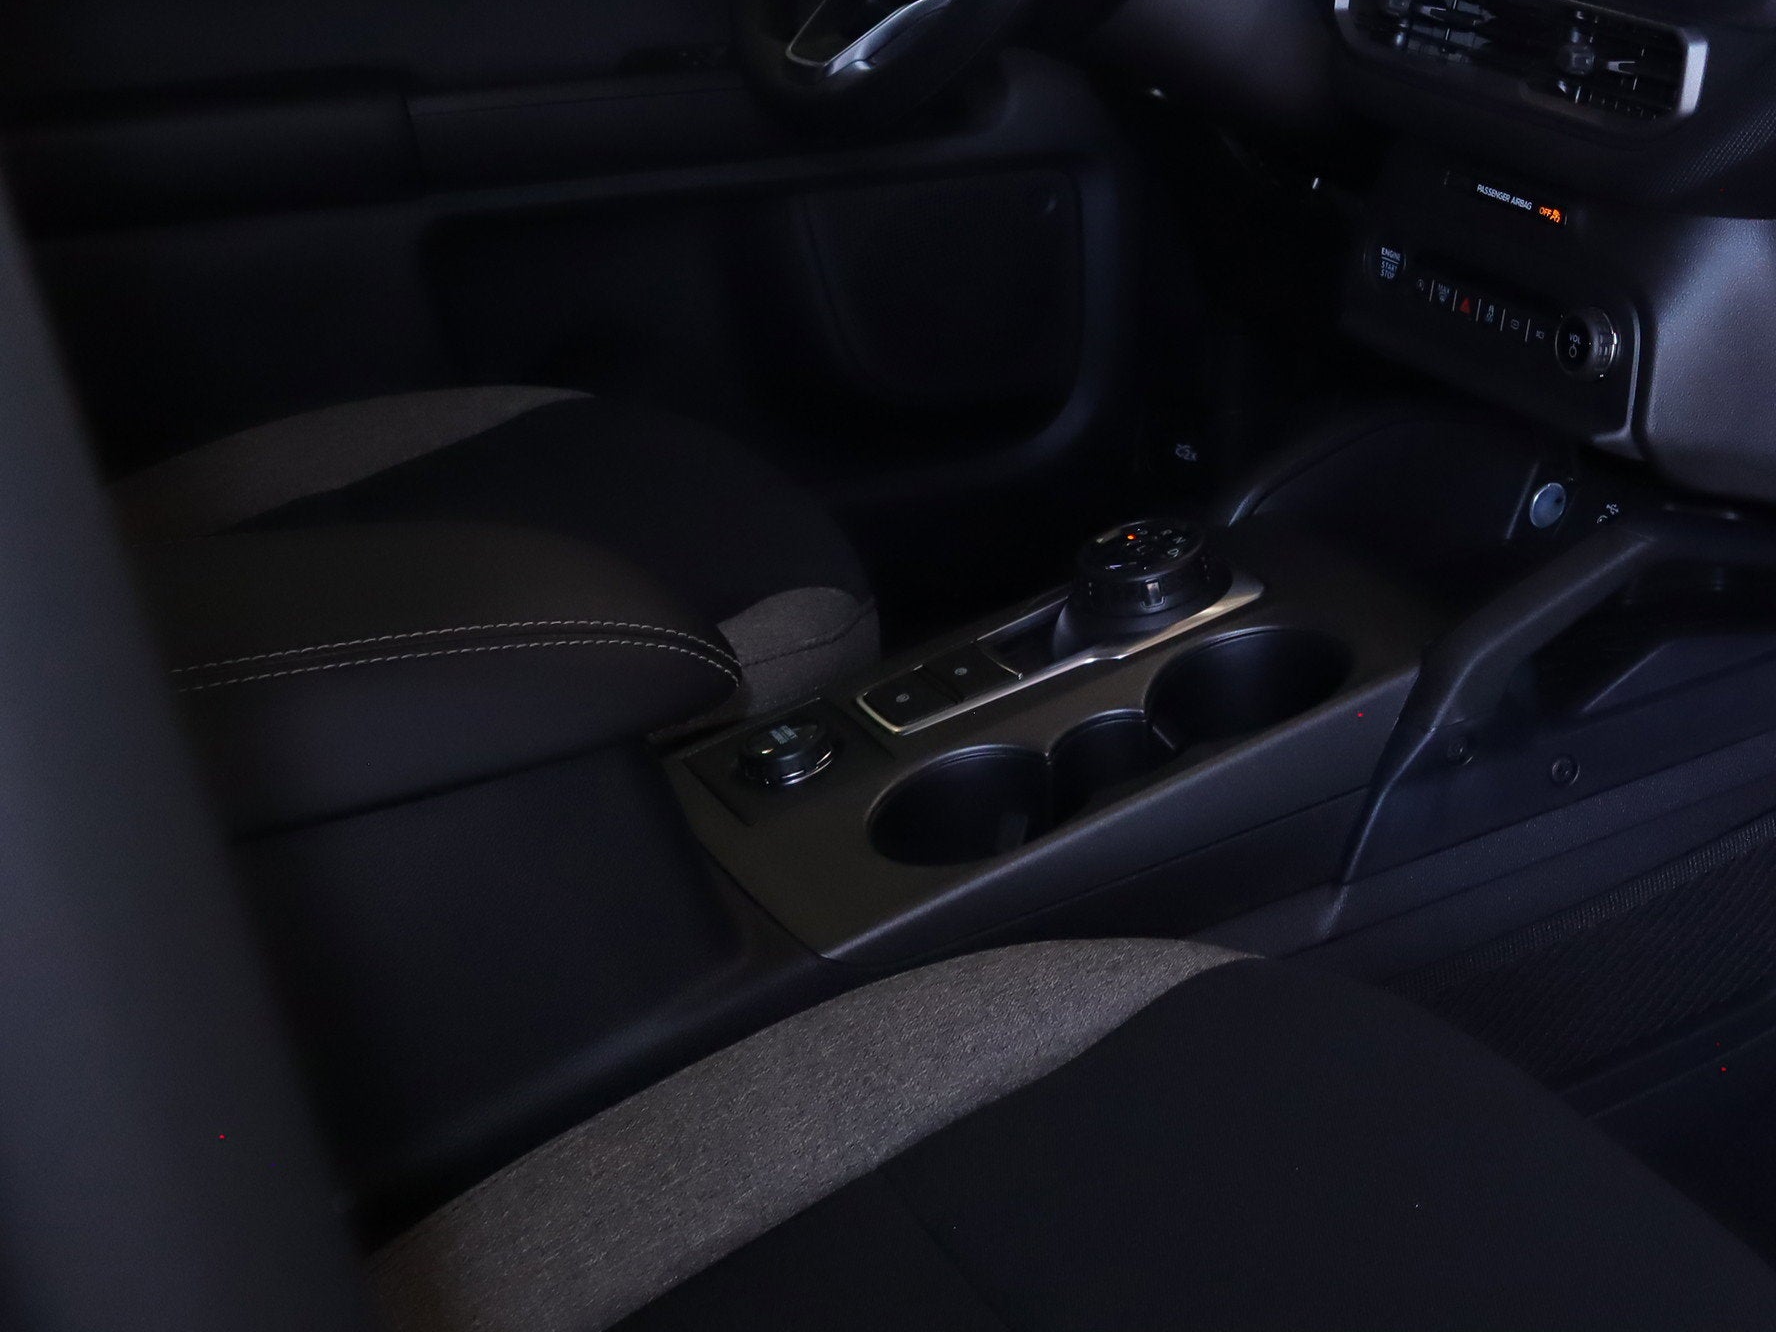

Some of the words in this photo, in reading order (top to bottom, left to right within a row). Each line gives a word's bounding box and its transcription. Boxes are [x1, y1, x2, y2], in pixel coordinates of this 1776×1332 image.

[1476, 183, 1511, 203] PASSENGER
[1510, 196, 1533, 210] AIRBAG
[1539, 207, 1552, 217] OFF
[1569, 333, 1581, 345] VOL
